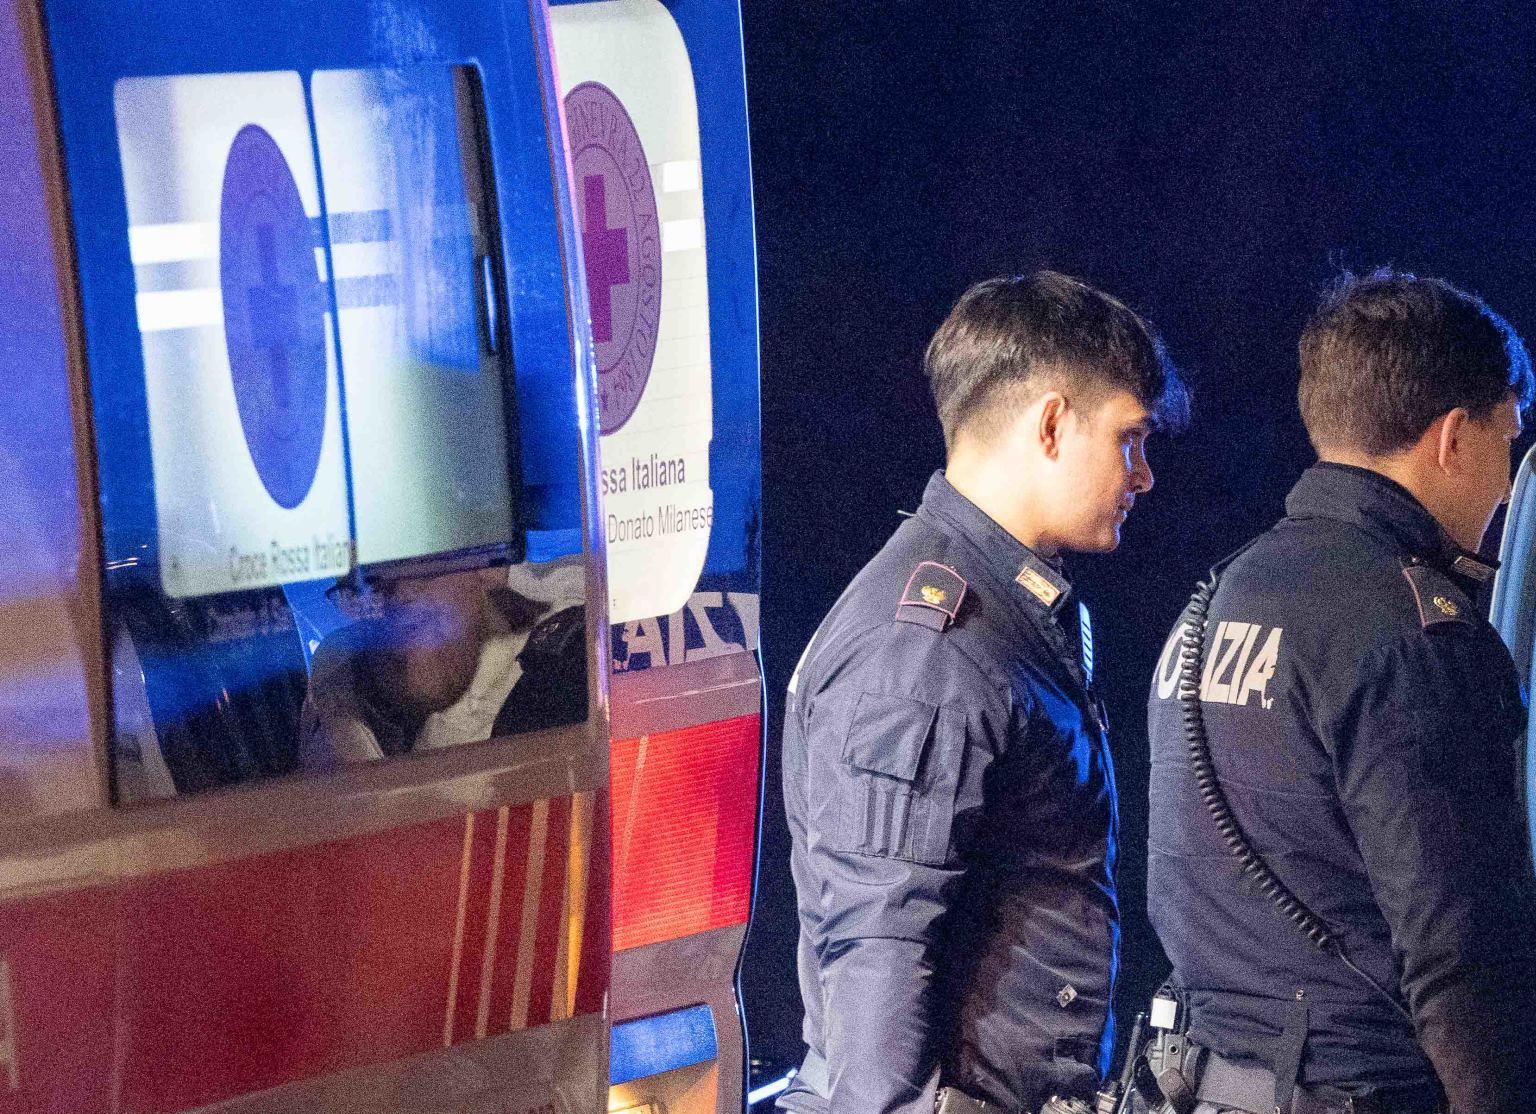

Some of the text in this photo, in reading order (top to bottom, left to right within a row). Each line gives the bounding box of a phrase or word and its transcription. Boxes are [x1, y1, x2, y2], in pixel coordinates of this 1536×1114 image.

[631, 454, 686, 492] Italiana
[608, 504, 713, 544] Donato Milanese
[1152, 621, 1284, 710] OIZIA
